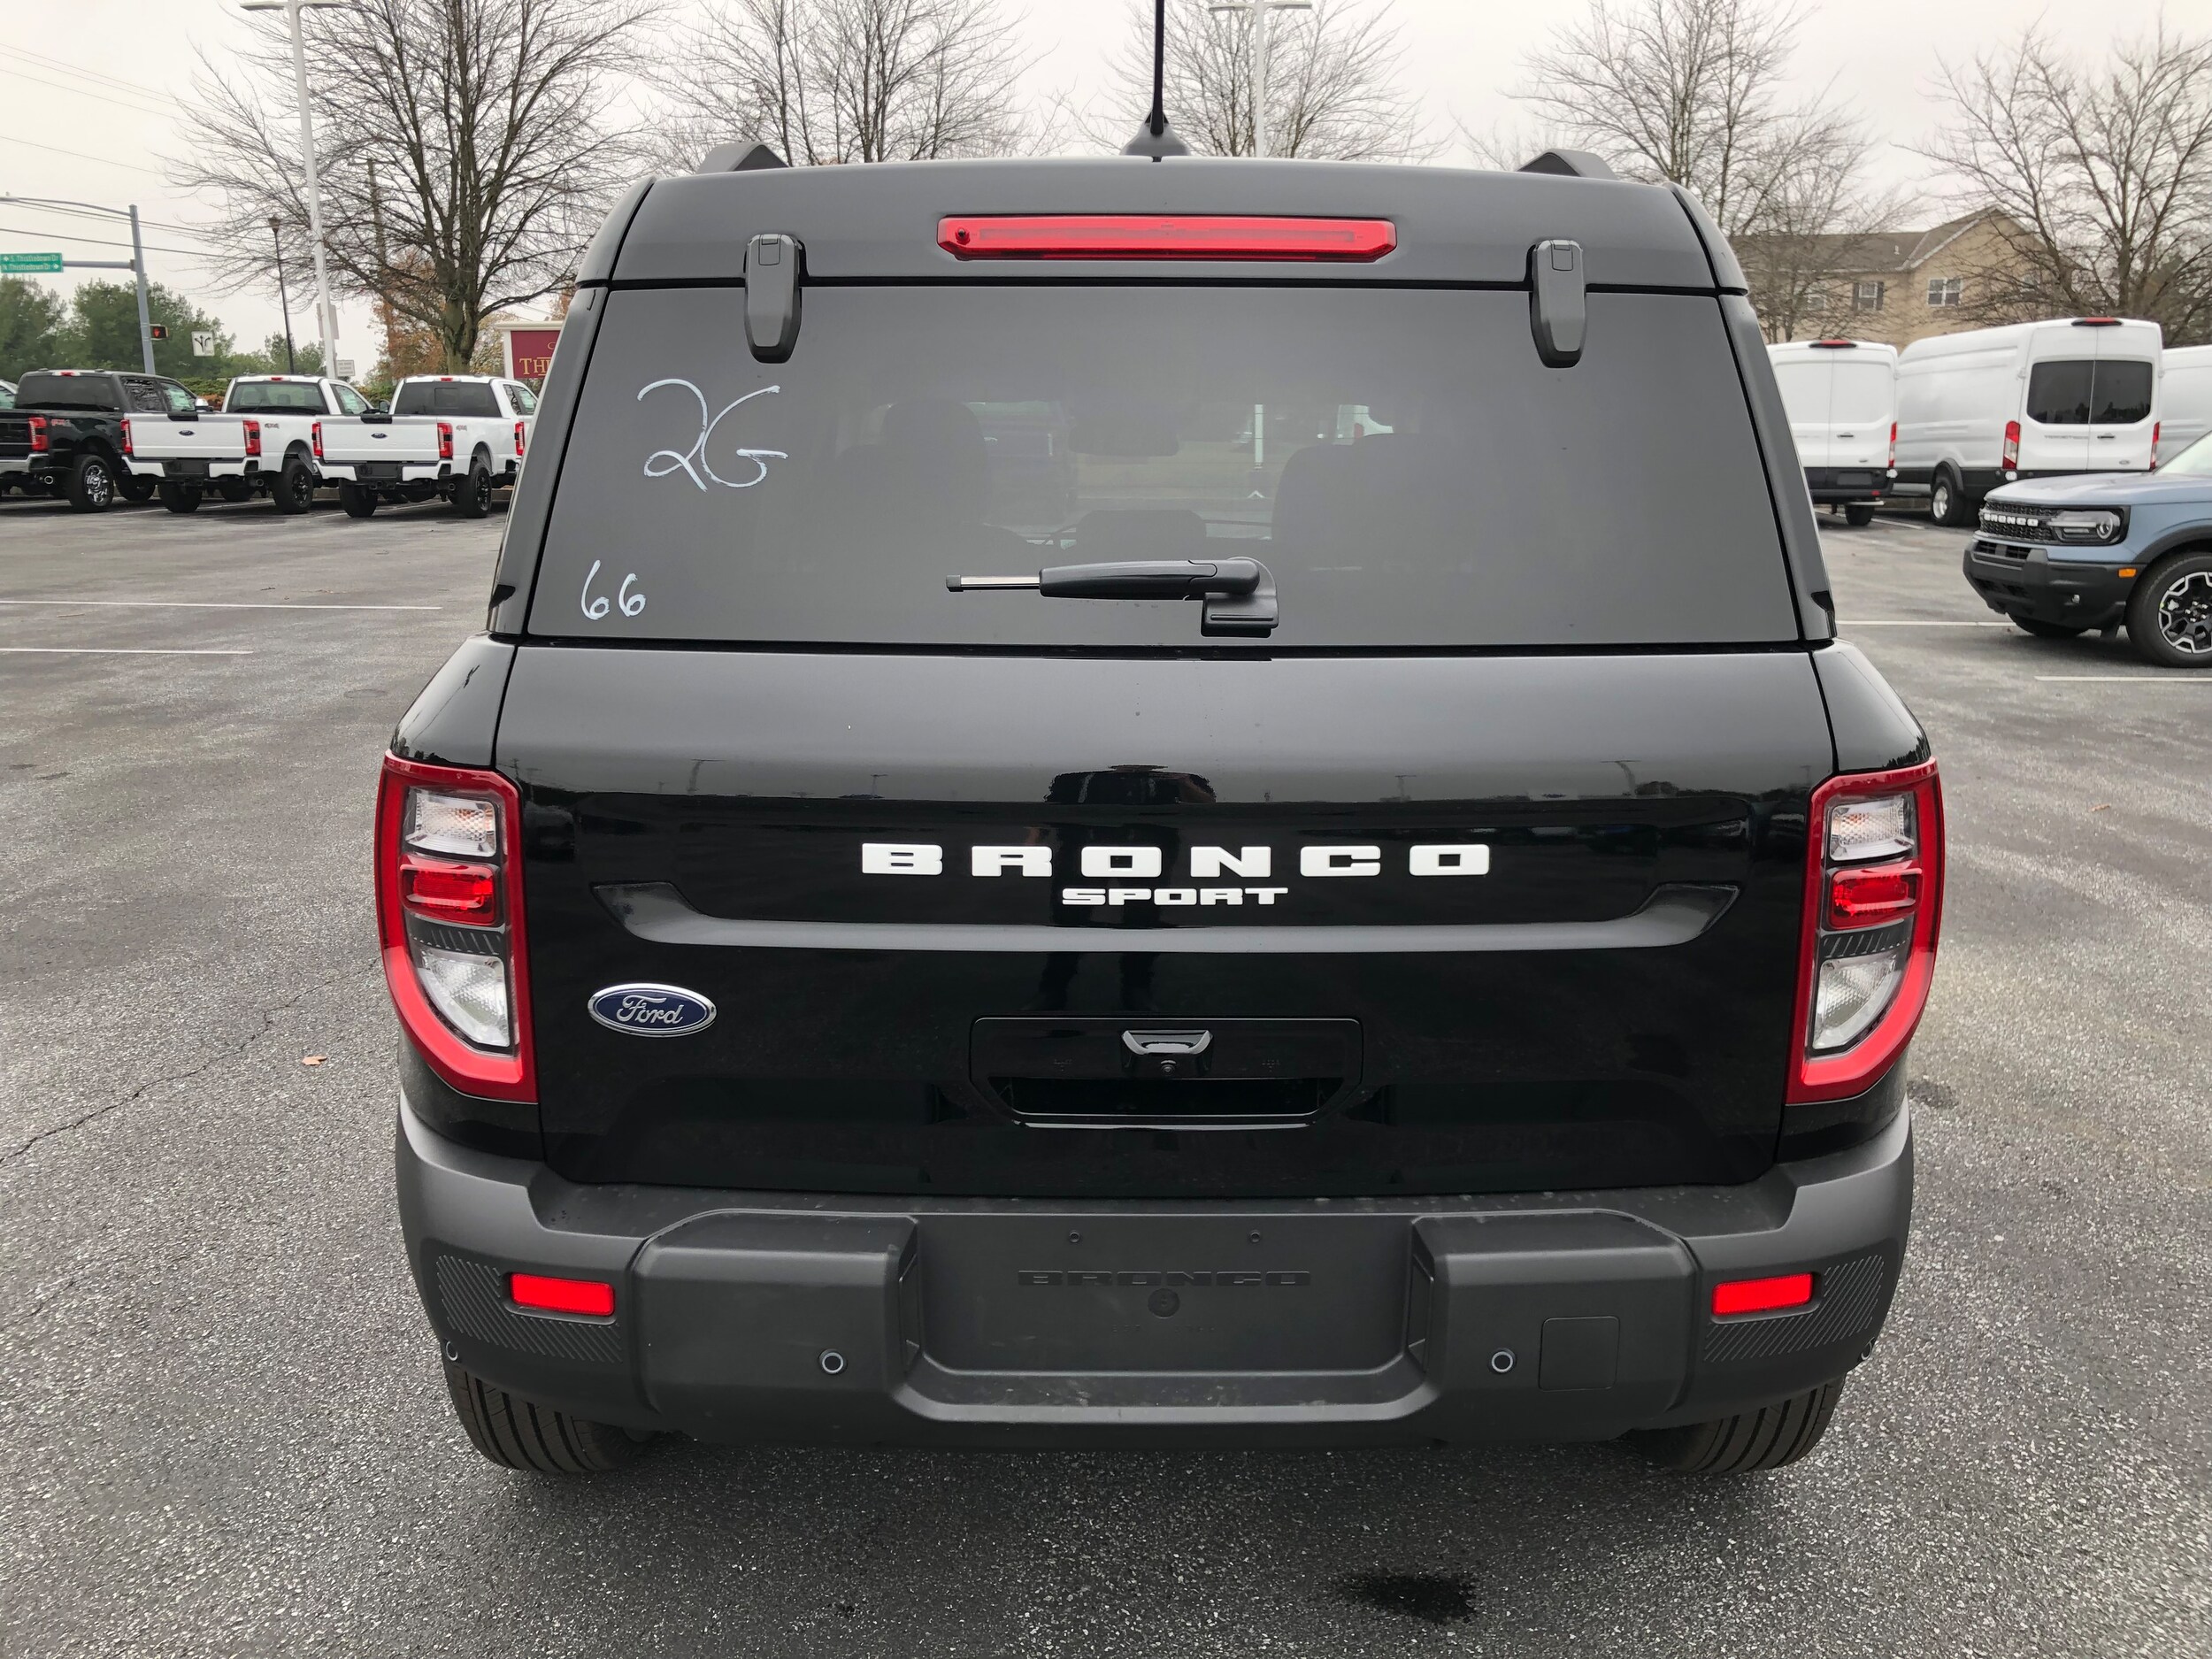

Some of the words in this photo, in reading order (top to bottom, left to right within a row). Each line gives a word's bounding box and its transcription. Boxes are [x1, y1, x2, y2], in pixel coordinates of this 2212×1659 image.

[1983, 513, 2039, 527] BRONCO
[580, 559, 647, 620] 66
[862, 842, 1490, 878] BRONCO
[1062, 887, 1288, 905] SPORT
[616, 995, 684, 1025] Ford
[1018, 1270, 1310, 1286] BRONCO
